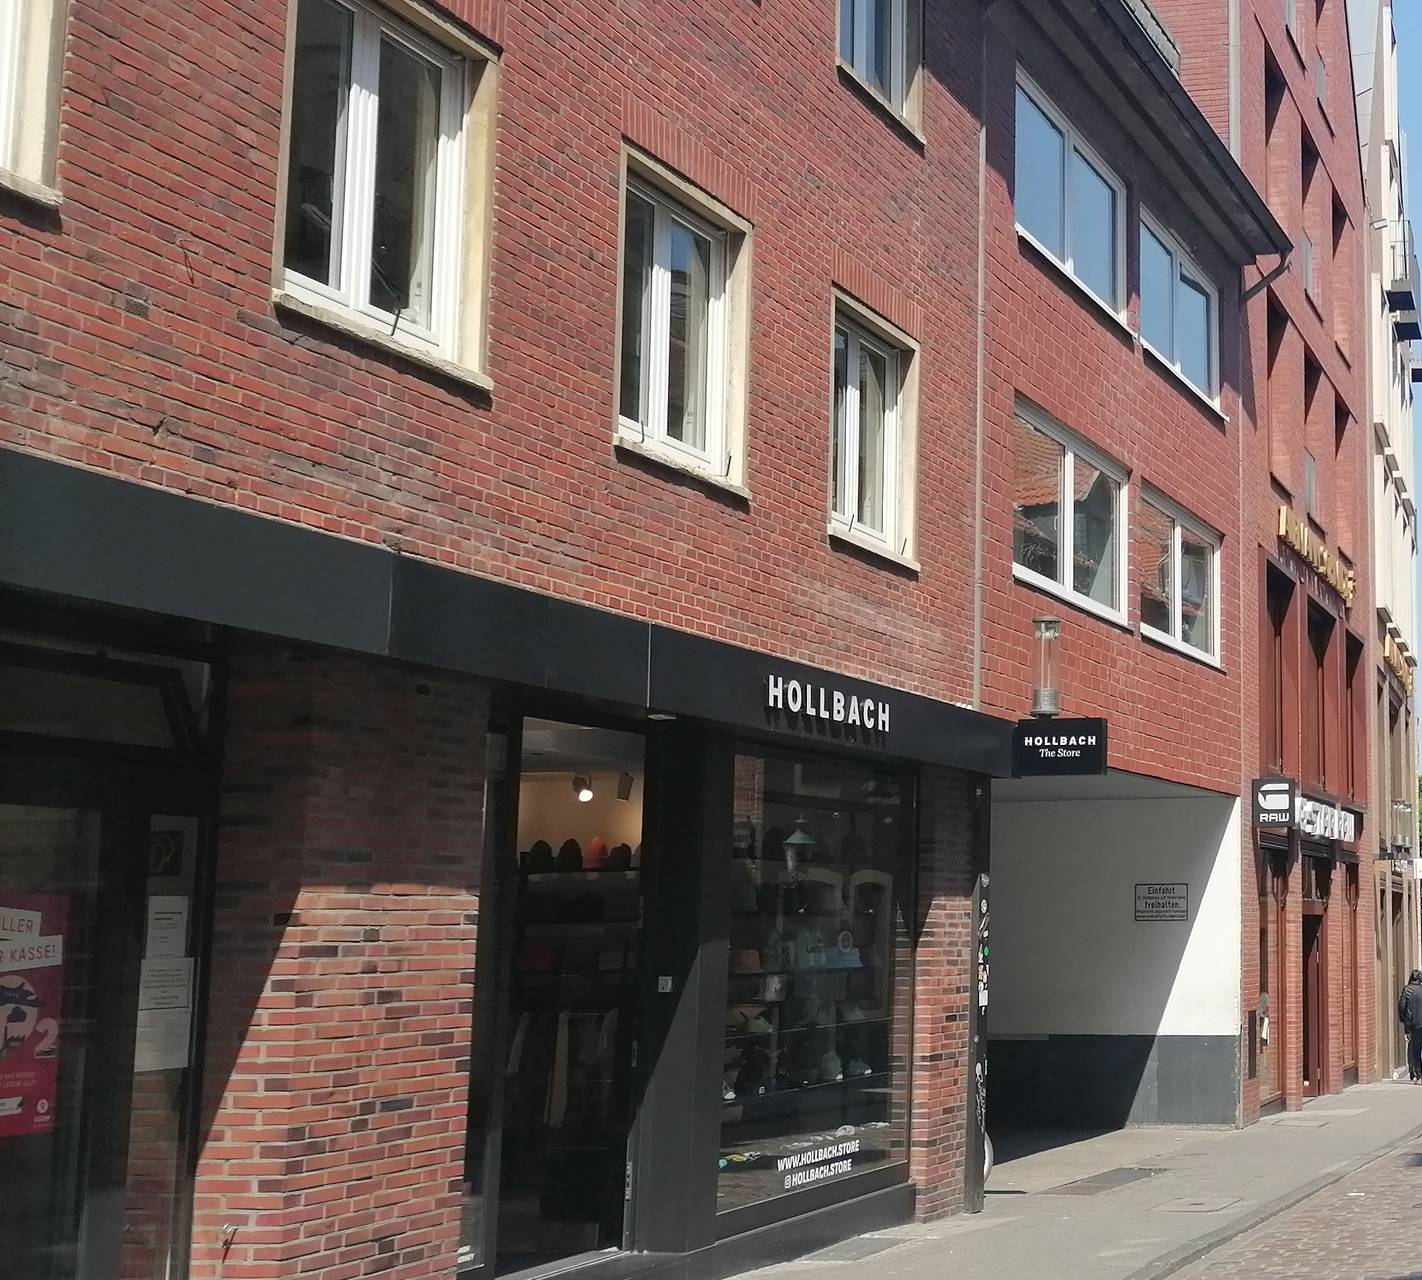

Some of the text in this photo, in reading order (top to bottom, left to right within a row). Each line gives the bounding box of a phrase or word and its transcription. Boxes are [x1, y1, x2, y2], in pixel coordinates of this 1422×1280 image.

[768, 674, 890, 732] HOLLBACH
[1024, 736, 1097, 746] HOLLBACH
[1039, 748, 1081, 758] The Store
[1259, 812, 1290, 823] RAW
[1147, 886, 1176, 895] Einfahrt
[10, 944, 56, 962] KASSE!
[777, 1139, 860, 1172] WWW.HOLLBACH.STORE
